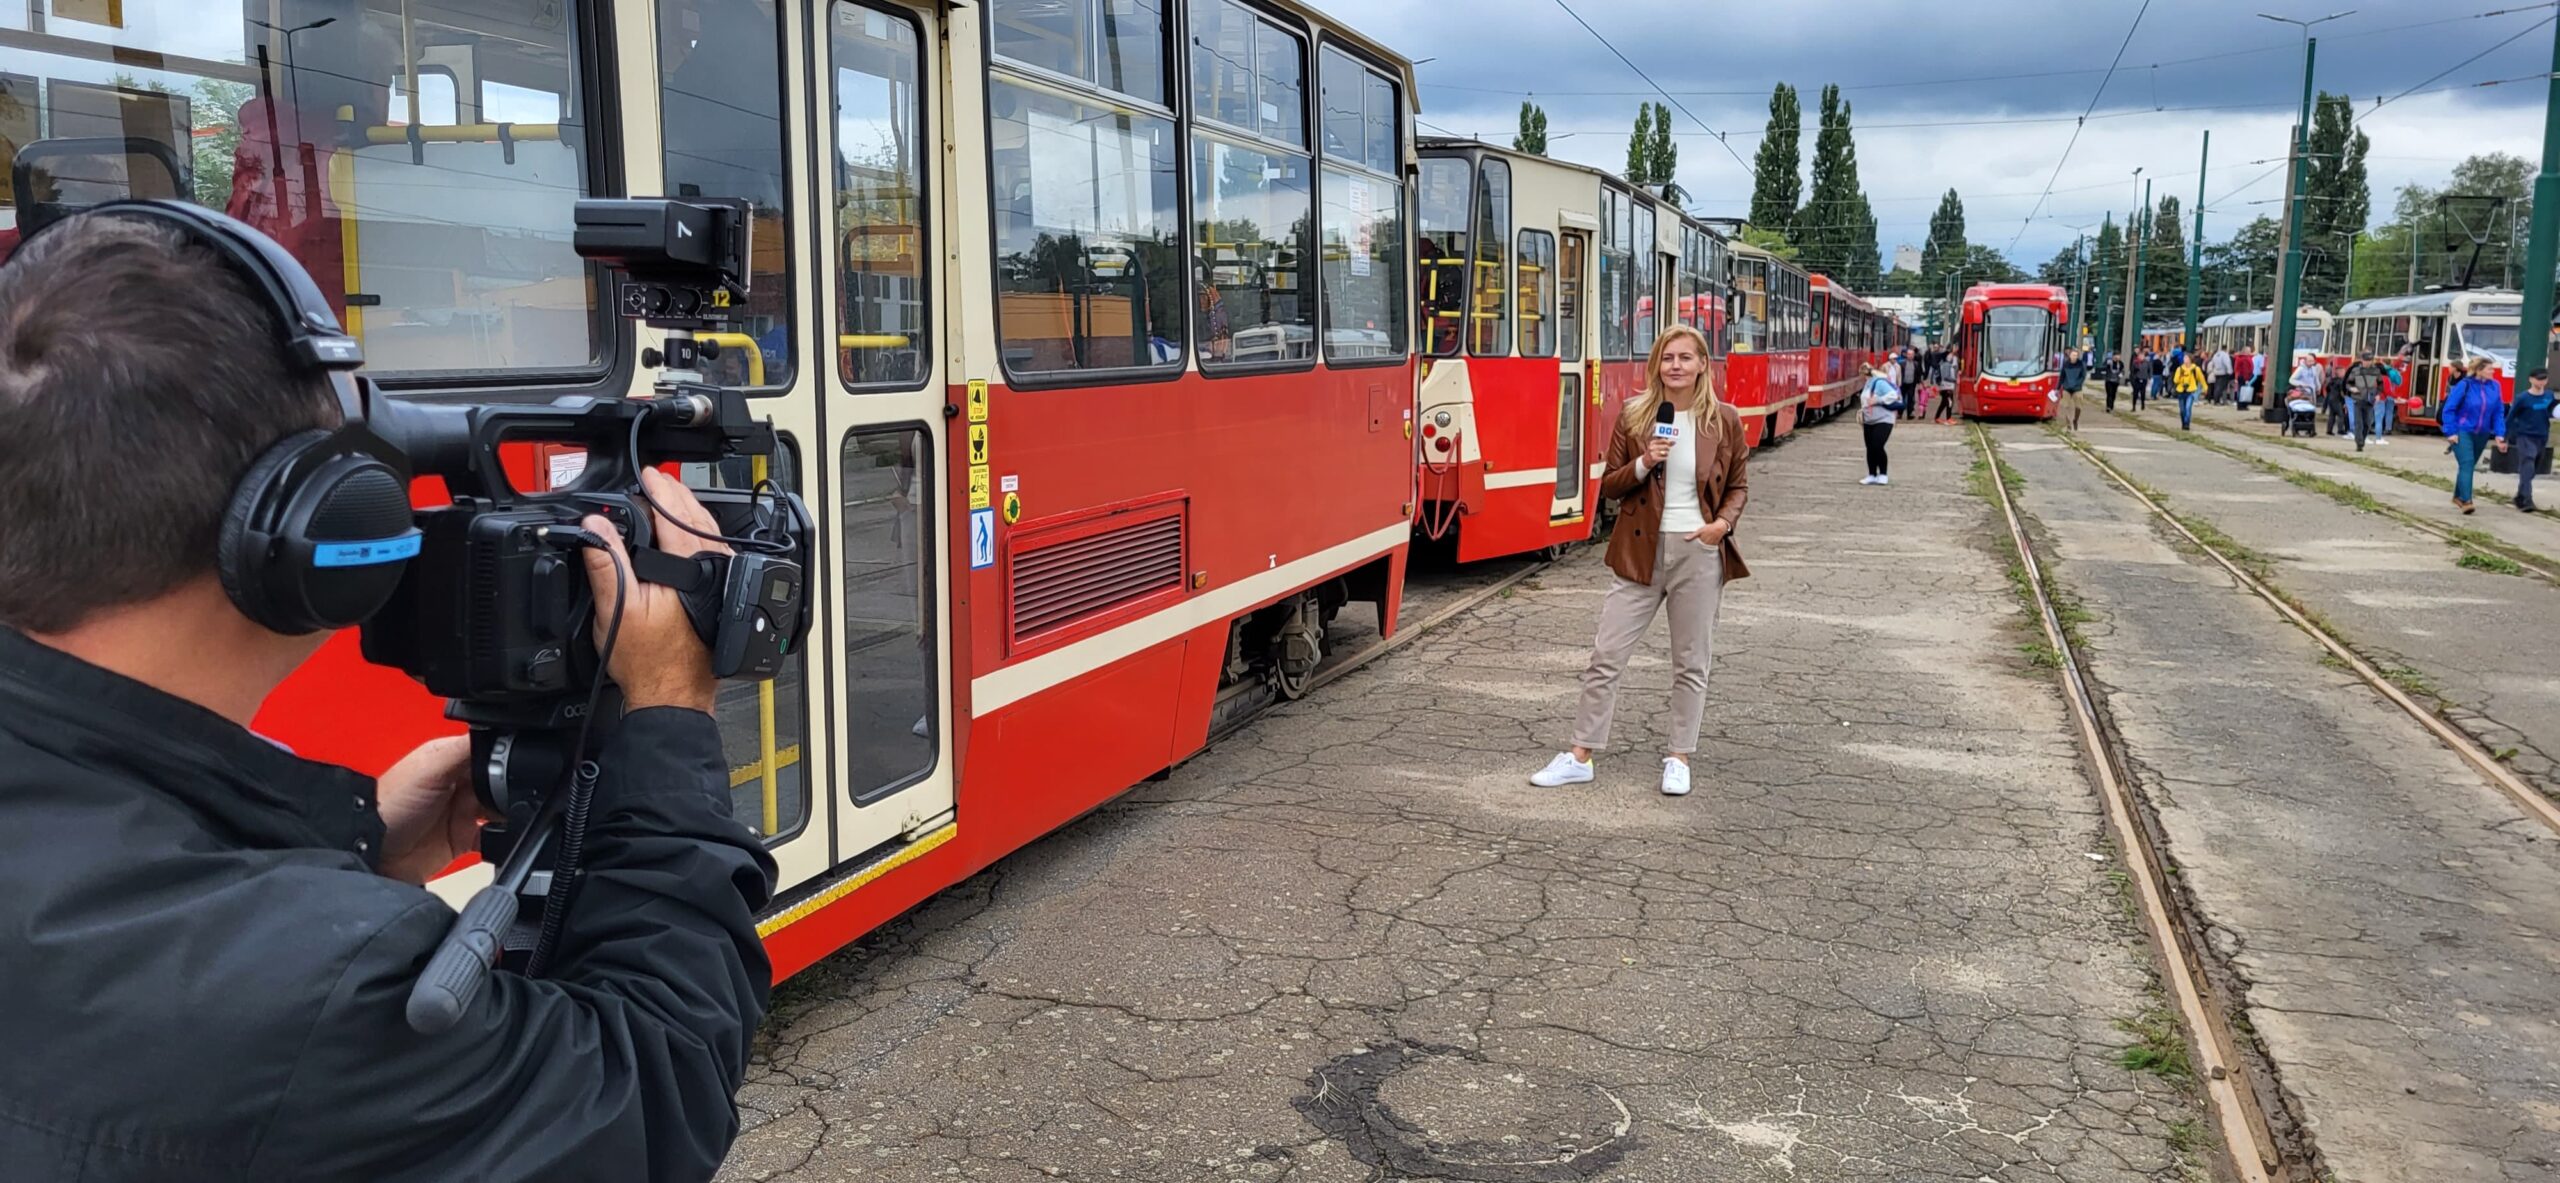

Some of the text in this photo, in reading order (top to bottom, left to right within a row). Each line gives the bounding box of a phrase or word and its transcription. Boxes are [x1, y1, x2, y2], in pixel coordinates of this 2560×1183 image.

[677, 220, 693, 239] 7
[712, 289, 731, 308] 12
[681, 347, 692, 360] 10
